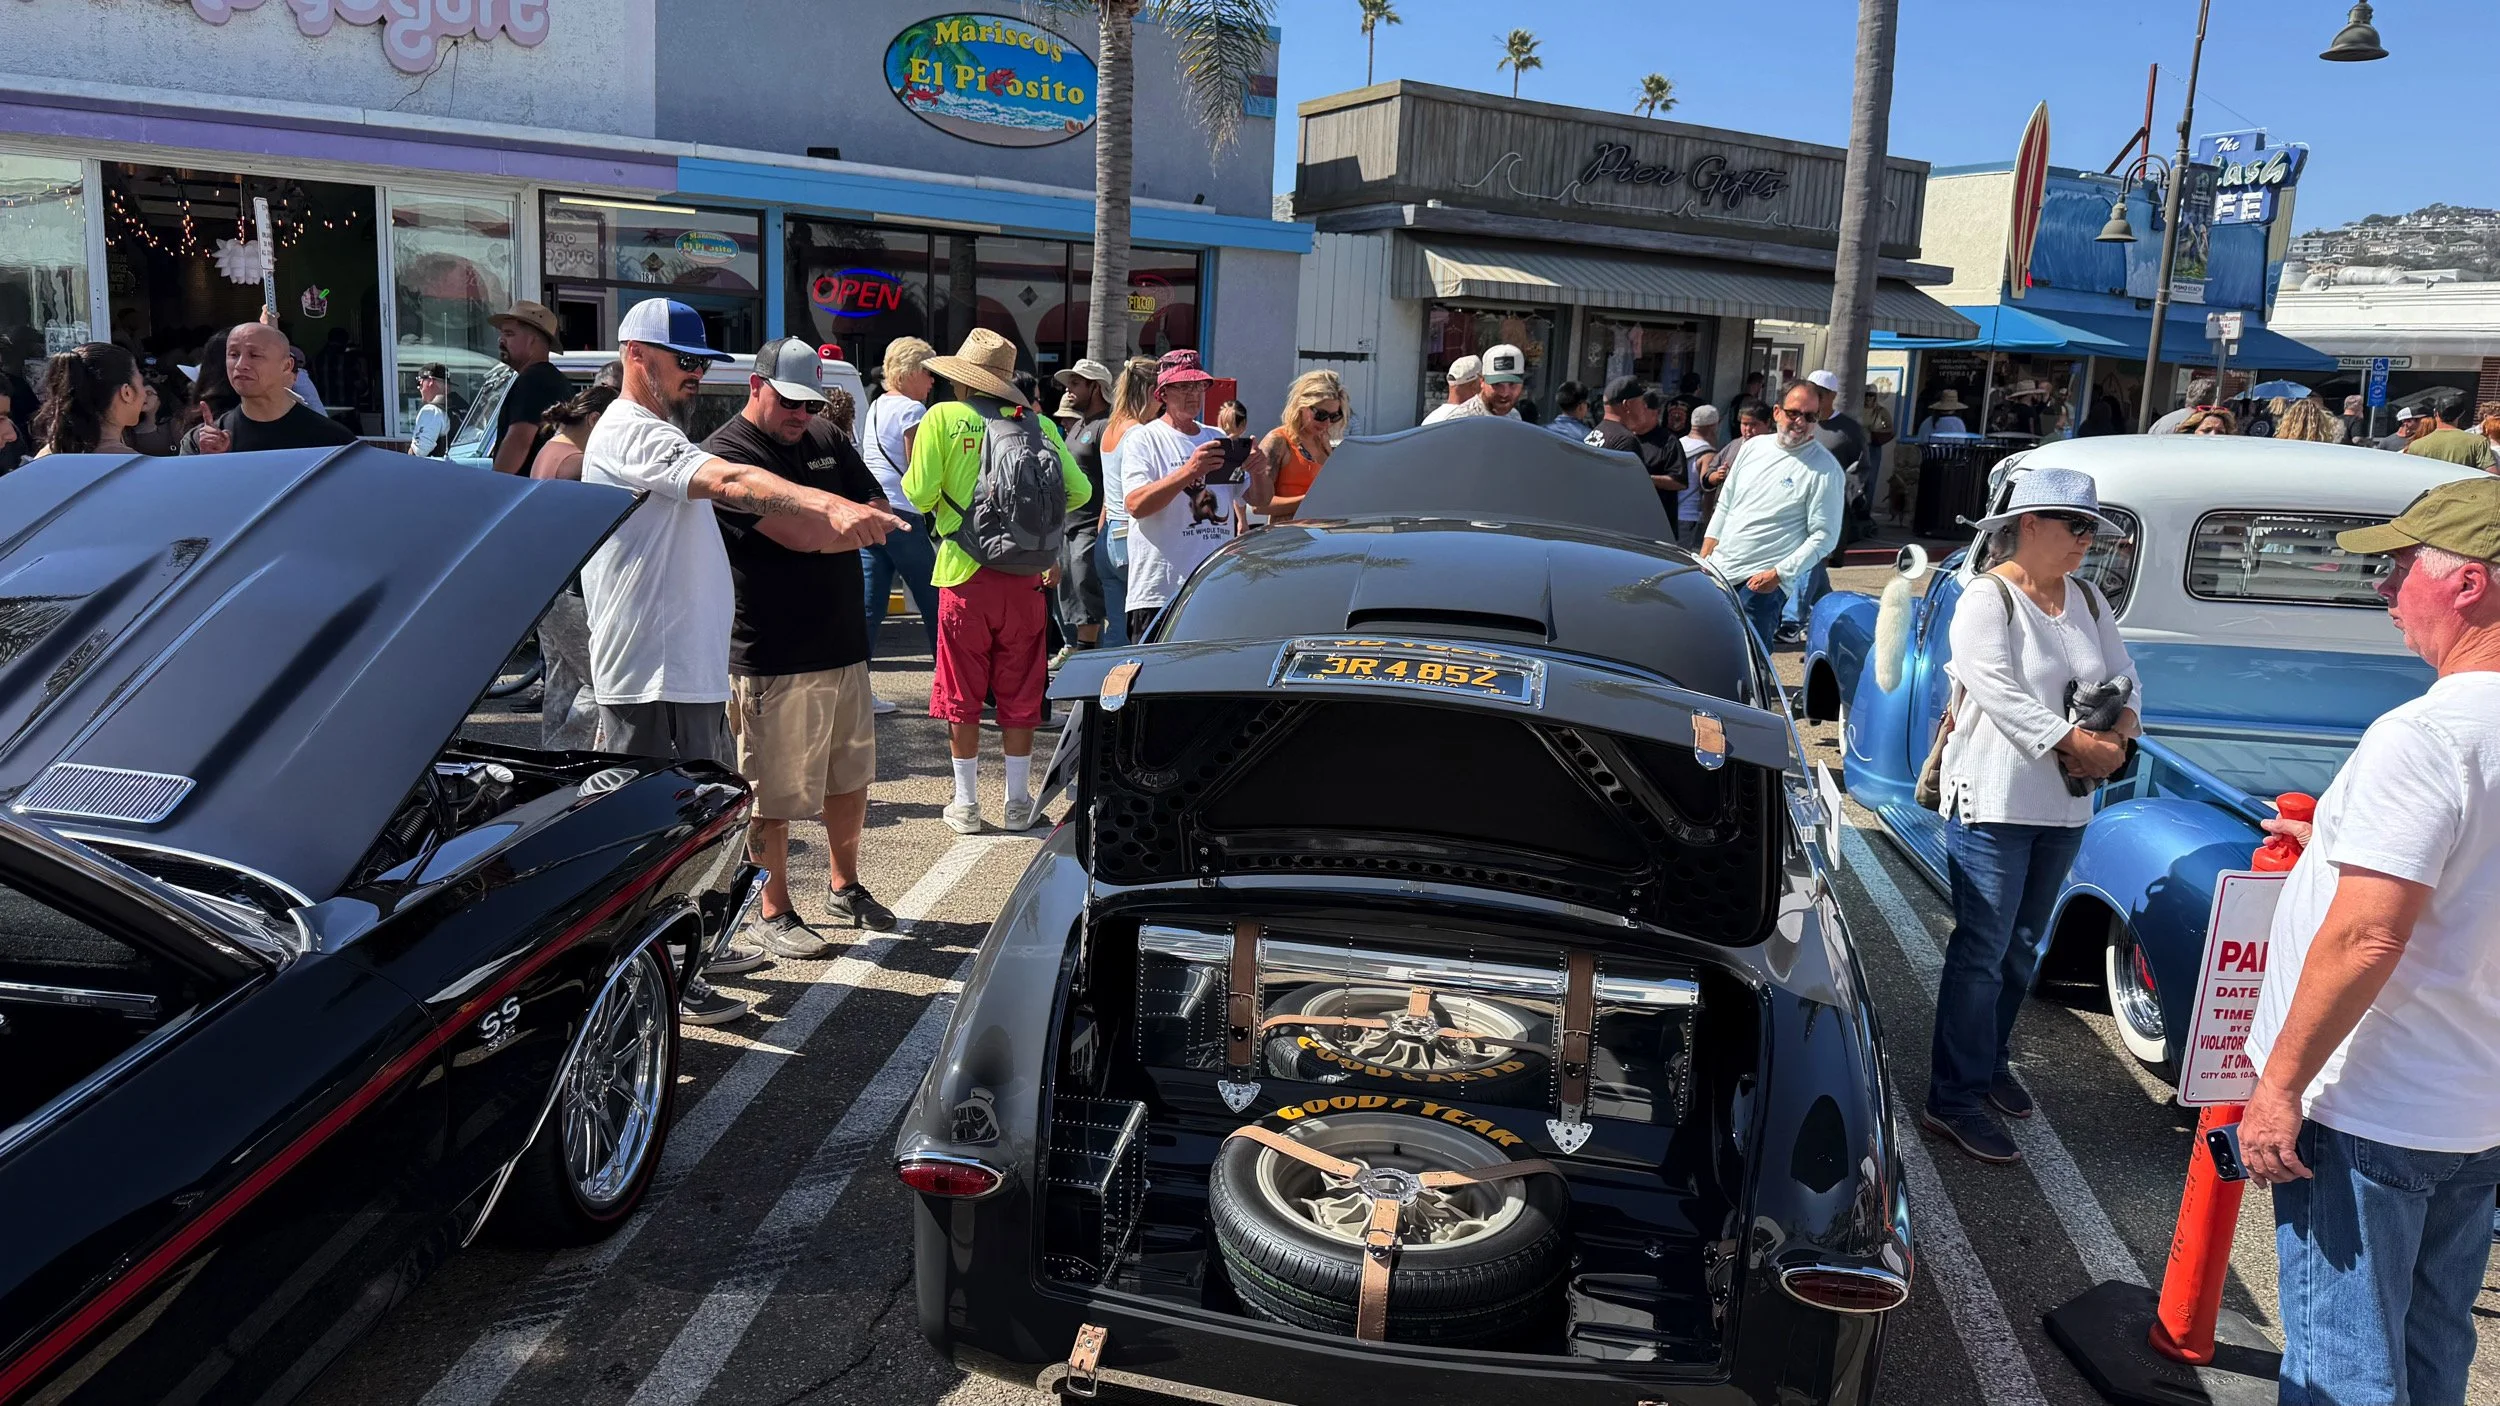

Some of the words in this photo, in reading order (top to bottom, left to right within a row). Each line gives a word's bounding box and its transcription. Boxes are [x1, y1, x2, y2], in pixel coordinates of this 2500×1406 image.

[935, 20, 1063, 63] Mariscos
[909, 58, 943, 86] El
[2215, 137, 2240, 152] The
[1581, 142, 1686, 186] Pier
[1691, 154, 1790, 210] Gifts
[812, 276, 904, 311] OPEN
[481, 996, 521, 1039] SS
[2230, 1025, 2242, 1033] BY
[2200, 1071, 2219, 1079] CITY
[2221, 1055, 2234, 1069] AT
